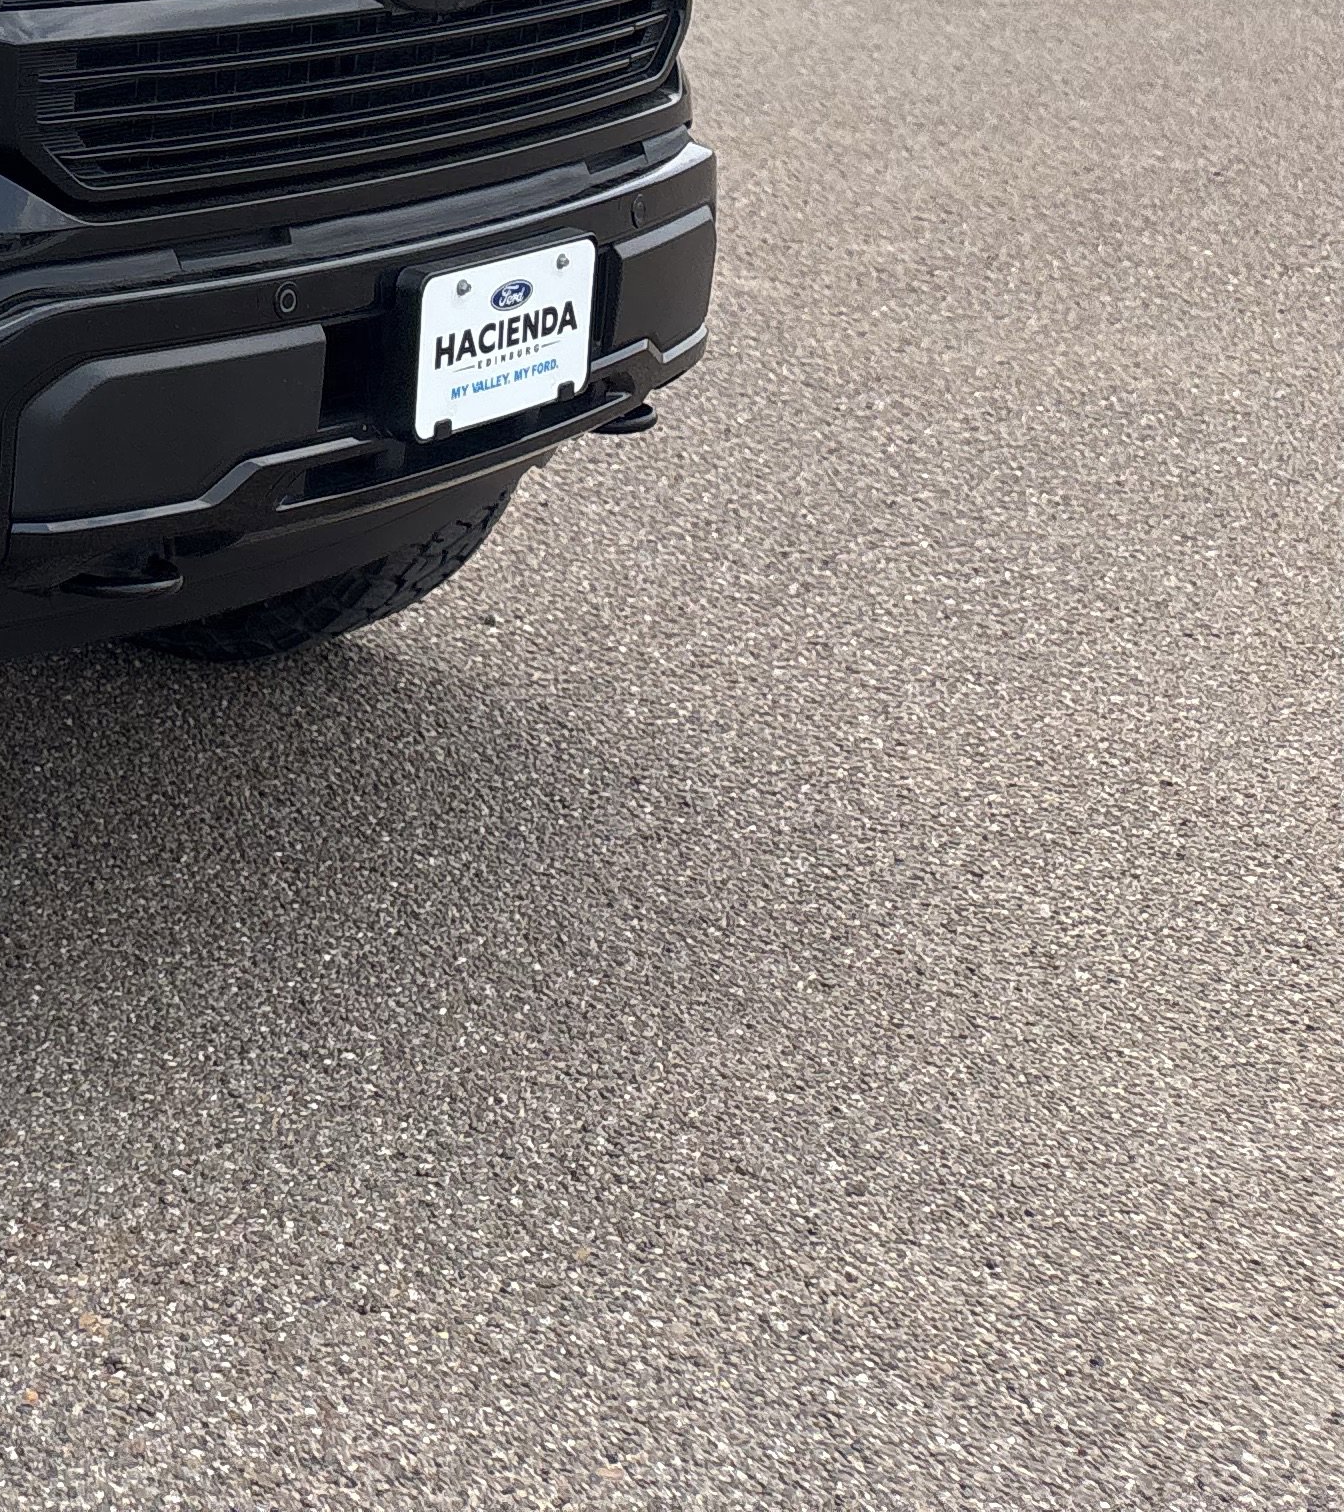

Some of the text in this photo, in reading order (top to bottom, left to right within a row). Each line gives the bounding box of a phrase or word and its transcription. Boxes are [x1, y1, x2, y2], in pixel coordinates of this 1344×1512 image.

[498, 284, 525, 306] Ford
[433, 300, 578, 370] HACIENDA
[477, 343, 540, 370] EDINBURG
[450, 357, 559, 400] MY VALLEY. MY FORD.
